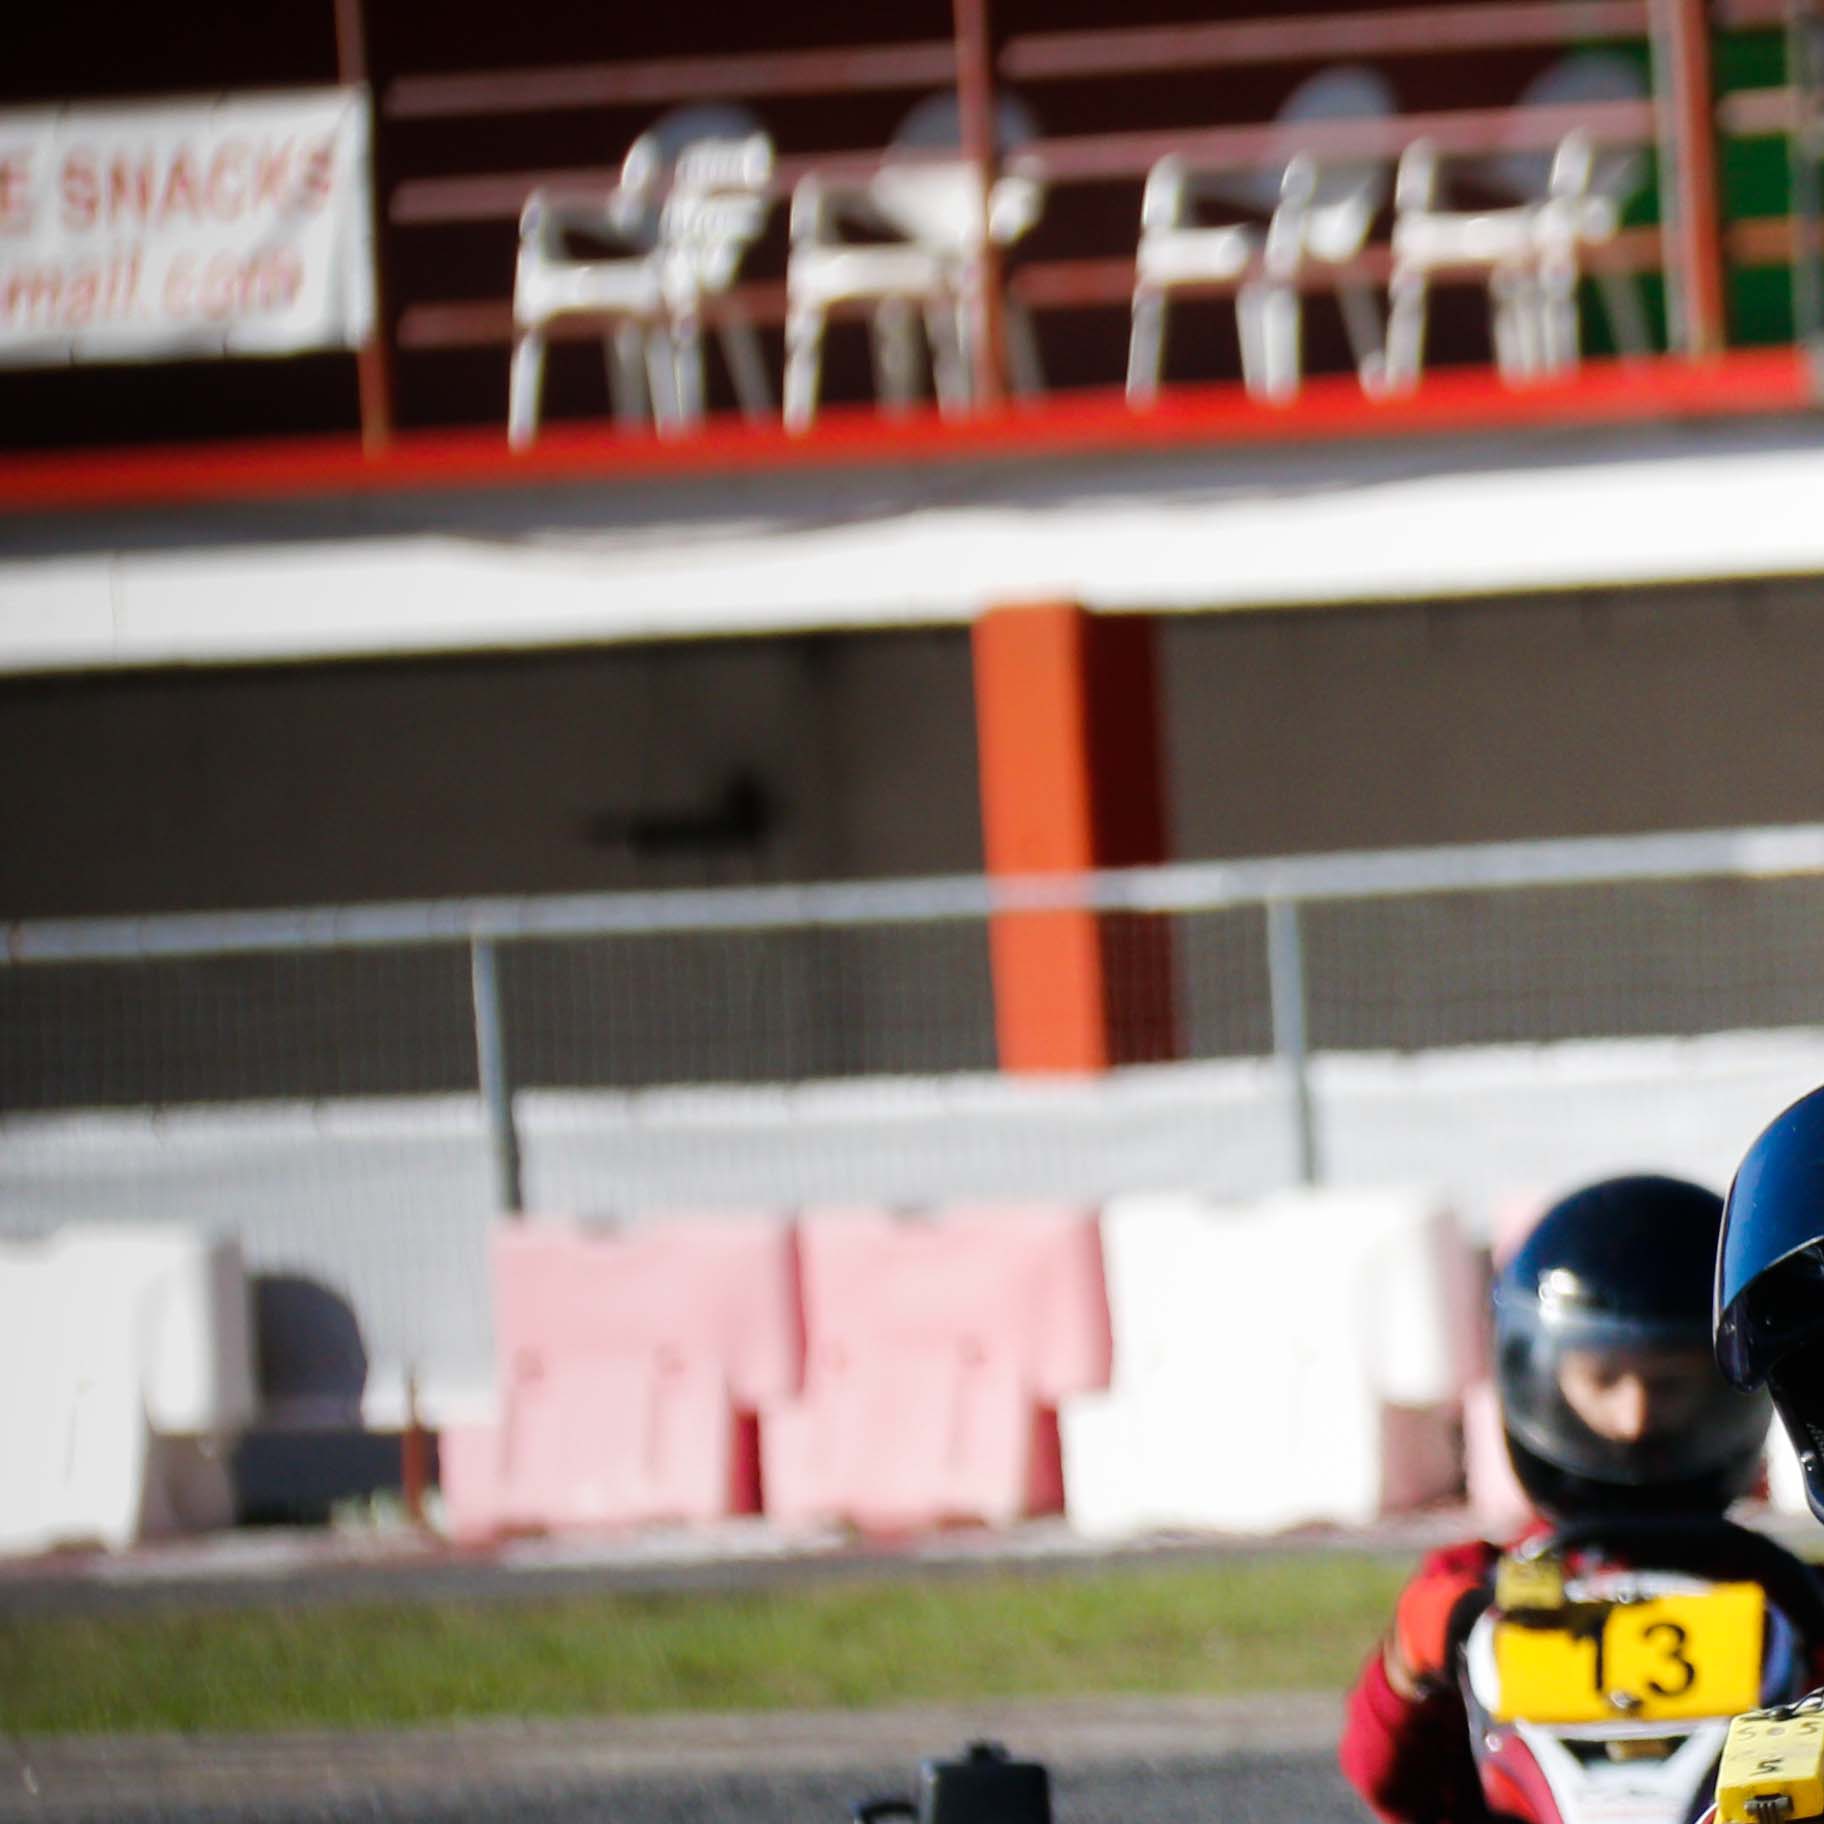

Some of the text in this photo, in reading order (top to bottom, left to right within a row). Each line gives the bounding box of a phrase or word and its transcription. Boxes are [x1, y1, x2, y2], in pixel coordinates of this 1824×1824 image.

[61, 135, 342, 236] SNACKS
[0, 240, 306, 330] mail.com
[1574, 1618, 1695, 1697] 13
